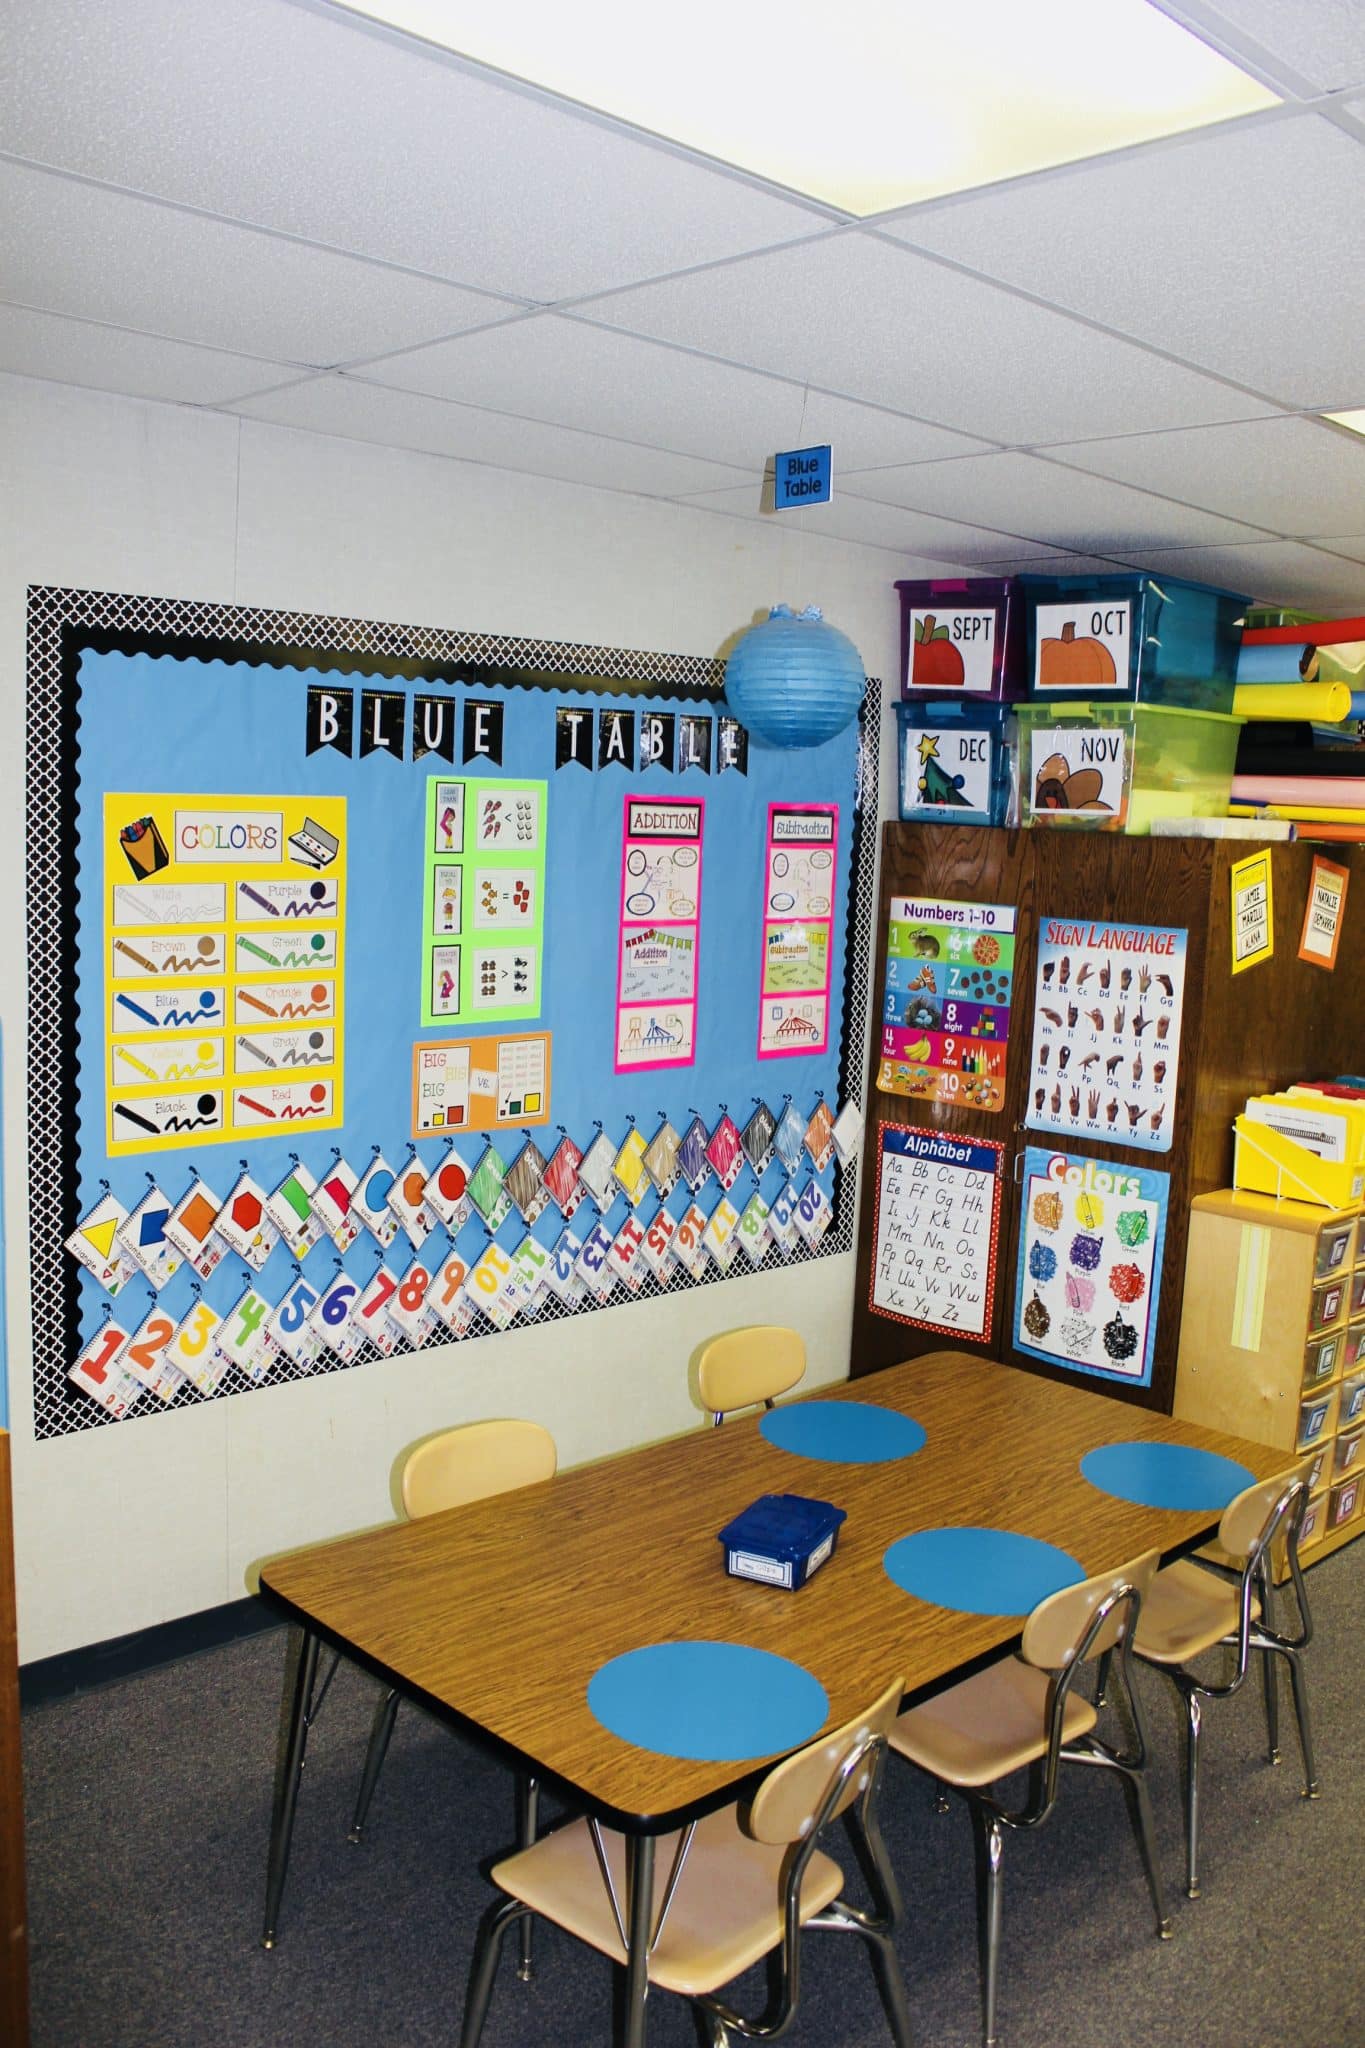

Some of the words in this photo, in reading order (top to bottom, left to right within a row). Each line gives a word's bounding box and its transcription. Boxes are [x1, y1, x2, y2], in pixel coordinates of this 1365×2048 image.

[788, 458, 818, 476] Blue
[784, 477, 822, 498] Table
[953, 617, 992, 641] SEPT
[1091, 610, 1126, 635] OCT
[320, 695, 491, 753] BLUE
[566, 715, 738, 765] TABLE
[960, 738, 986, 762] DEC
[1081, 737, 1120, 762] NOV
[634, 813, 697, 829] ADDITION
[777, 820, 829, 835] Subtraction
[182, 824, 278, 849] COLORS
[268, 885, 302, 898] Purple
[904, 902, 964, 923] Numbers
[969, 908, 995, 925] 1-10
[151, 940, 186, 953] Brown
[272, 936, 302, 948] Green
[891, 928, 898, 945] 1
[951, 933, 963, 951] 6
[1045, 921, 1085, 948] SIGN
[1087, 924, 1179, 955] LANGUAGE
[634, 947, 668, 959] Addition
[950, 952, 960, 960] six
[889, 961, 897, 978] 2
[950, 968, 960, 986] 7
[156, 995, 179, 1007] Blue
[266, 987, 301, 1000] Orange
[887, 994, 895, 1012] 3
[947, 988, 968, 997] seven
[1042, 984, 1052, 992] Aa
[1058, 985, 1068, 994] Bb
[1077, 987, 1088, 996] Cc
[1099, 990, 1110, 998] Dd
[1120, 992, 1128, 1000] Ee
[1140, 994, 1148, 1003] Ff
[1160, 996, 1173, 1007] Gg
[946, 1003, 957, 1022] 8
[885, 1028, 894, 1046] 4
[944, 1022, 963, 1033] eight
[1042, 1026, 1052, 1035] Hh
[1067, 1030, 1074, 1038] Ii
[1090, 1033, 1097, 1043] Jj
[1112, 1036, 1123, 1045] Kk
[1134, 1039, 1141, 1047] Ll
[1154, 1042, 1169, 1050] Mm
[272, 1036, 299, 1048] Gray
[944, 1038, 955, 1056] 9
[424, 1053, 447, 1068] BIG
[446, 1064, 467, 1080] BIG
[884, 1062, 892, 1079] 5
[942, 1057, 958, 1066] nine
[423, 1083, 445, 1098] BIG
[941, 1072, 959, 1091] 10
[1038, 1067, 1048, 1076] Nn
[1057, 1070, 1068, 1079] Oo
[1082, 1074, 1092, 1084] Pp
[1106, 1077, 1120, 1089] Qq
[1132, 1081, 1141, 1090] Rr
[1154, 1085, 1163, 1094] Ss
[156, 1100, 187, 1114] Black
[272, 1089, 291, 1101] Red
[1035, 1111, 1042, 1119] Tt
[1051, 1114, 1061, 1123] Uu
[1070, 1117, 1080, 1126] Vv
[1086, 1120, 1100, 1129] Ww
[1107, 1124, 1117, 1133] Xx
[1129, 1127, 1138, 1137] Yy
[1150, 1131, 1160, 1141] Zz
[904, 1135, 972, 1162] Alphabet
[886, 1156, 902, 1173] Aa
[912, 1162, 928, 1178] Bb
[937, 1167, 954, 1184] Cc
[965, 1172, 987, 1191] Dd
[1048, 1155, 1141, 1197] Colors
[774, 1187, 798, 1226] 19
[800, 1183, 821, 1222] 20
[886, 1178, 901, 1195] Ee
[909, 1183, 928, 1200] Ff
[935, 1189, 953, 1212] Gg
[961, 1194, 983, 1213] Hh
[267, 1205, 292, 1236] rectangle
[711, 1204, 735, 1244] 17
[742, 1196, 767, 1236] 18
[887, 1200, 898, 1217] Ii
[906, 1206, 920, 1228] Jj
[929, 1210, 951, 1229] Kk
[962, 1217, 978, 1235] Ll
[170, 1232, 191, 1253] square
[220, 1224, 243, 1248] hexagon
[613, 1219, 643, 1263] 14
[648, 1211, 674, 1256] 15
[679, 1212, 705, 1249] 16
[888, 1223, 912, 1243] Mm
[923, 1231, 944, 1250] Nn
[956, 1239, 974, 1257] Oo
[72, 1243, 97, 1270] triangle
[122, 1236, 147, 1266] rhombus
[551, 1234, 580, 1281] 12
[583, 1228, 613, 1272] 13
[882, 1243, 896, 1262] Pp
[905, 1249, 923, 1275] Qq
[933, 1257, 951, 1274] Rr
[961, 1263, 978, 1280] Ss
[475, 1247, 510, 1294] 10
[362, 1272, 398, 1318] 7
[399, 1267, 430, 1312] 8
[441, 1261, 465, 1305] 9
[879, 1263, 890, 1281] Tt
[898, 1271, 915, 1289] Uu
[925, 1276, 940, 1294] Vv
[950, 1283, 980, 1303] Ww
[279, 1284, 317, 1333] 5
[322, 1285, 356, 1326] 6
[887, 1288, 904, 1307] Xx
[914, 1295, 930, 1320] Yy
[942, 1304, 959, 1321] Zz
[179, 1305, 218, 1357] 3
[235, 1294, 266, 1347] 4
[128, 1319, 174, 1370] 2
[377, 1334, 385, 1344] 6
[80, 1330, 126, 1384] 1
[302, 1358, 309, 1367] 6
[106, 1394, 115, 1404] 0
[114, 1404, 125, 1415] 2
